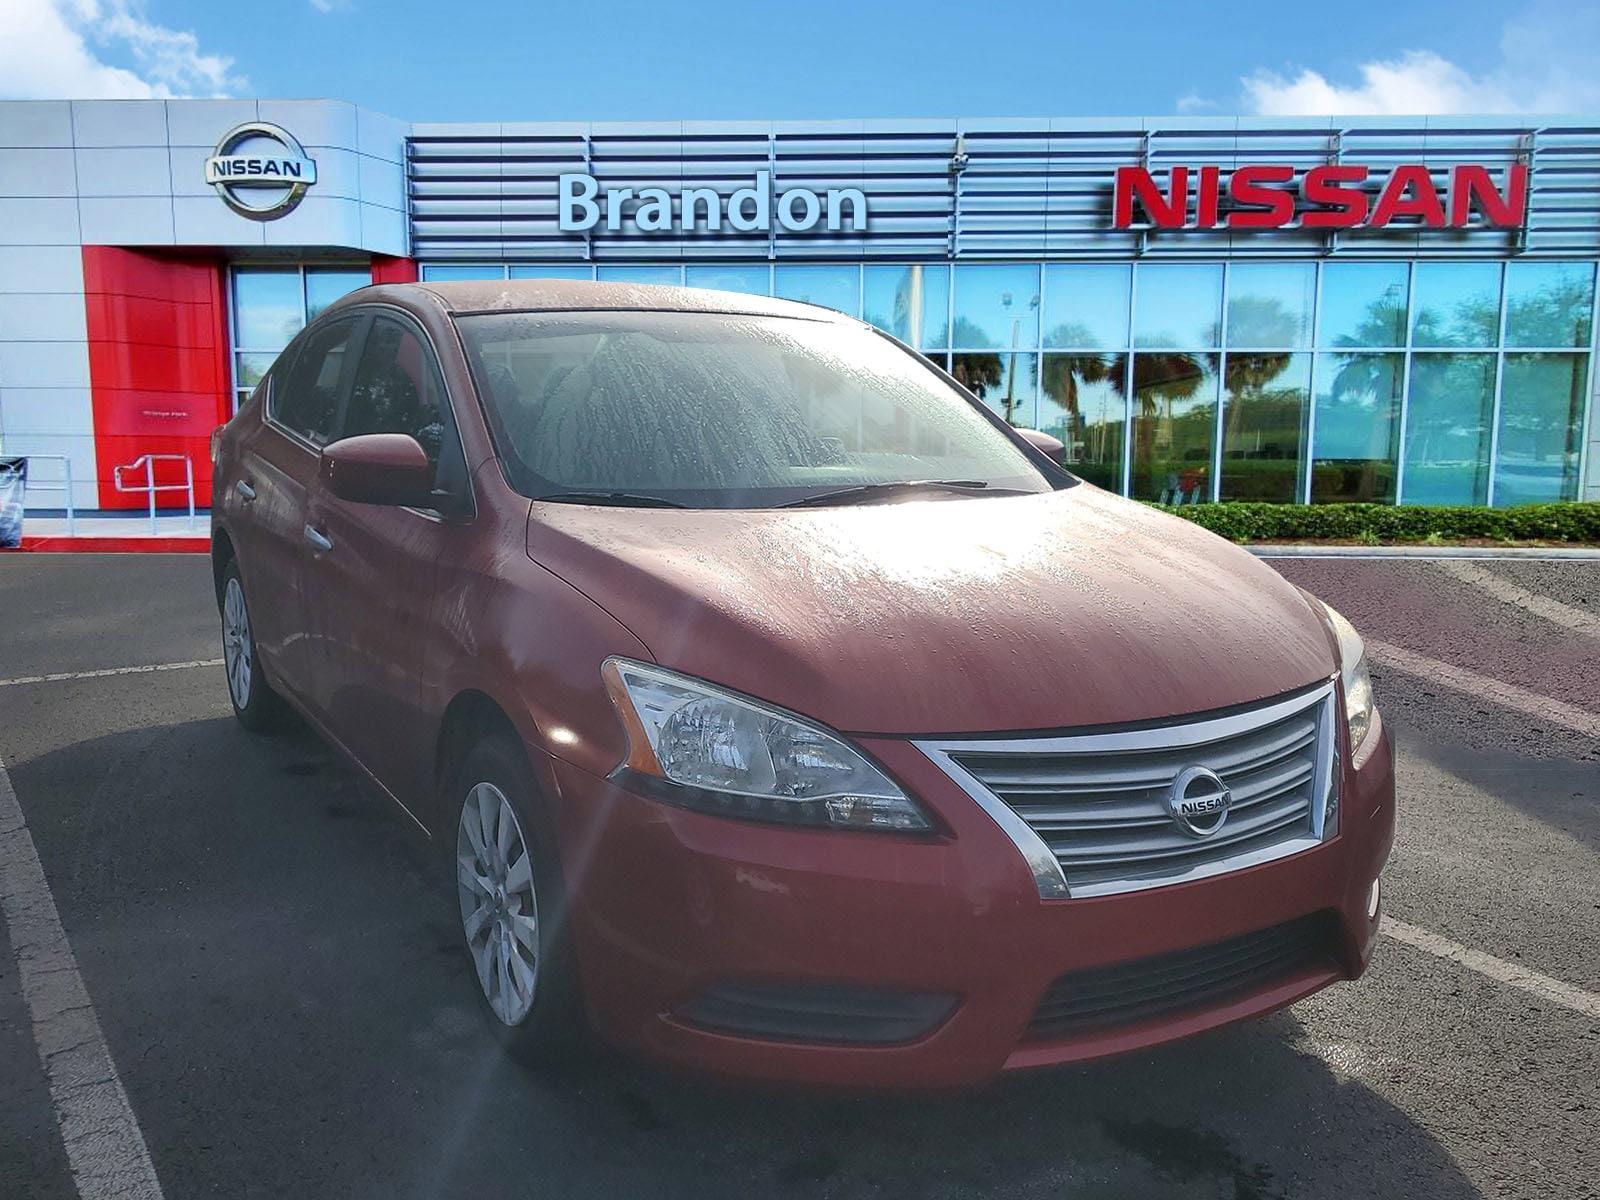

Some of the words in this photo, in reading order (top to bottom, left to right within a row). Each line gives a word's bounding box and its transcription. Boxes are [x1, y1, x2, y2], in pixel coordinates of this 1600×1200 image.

[212, 159, 302, 178] NISSAN
[559, 170, 867, 232] Brandon
[1113, 165, 1528, 229] NISSAN
[1181, 795, 1229, 814] NISSAN
